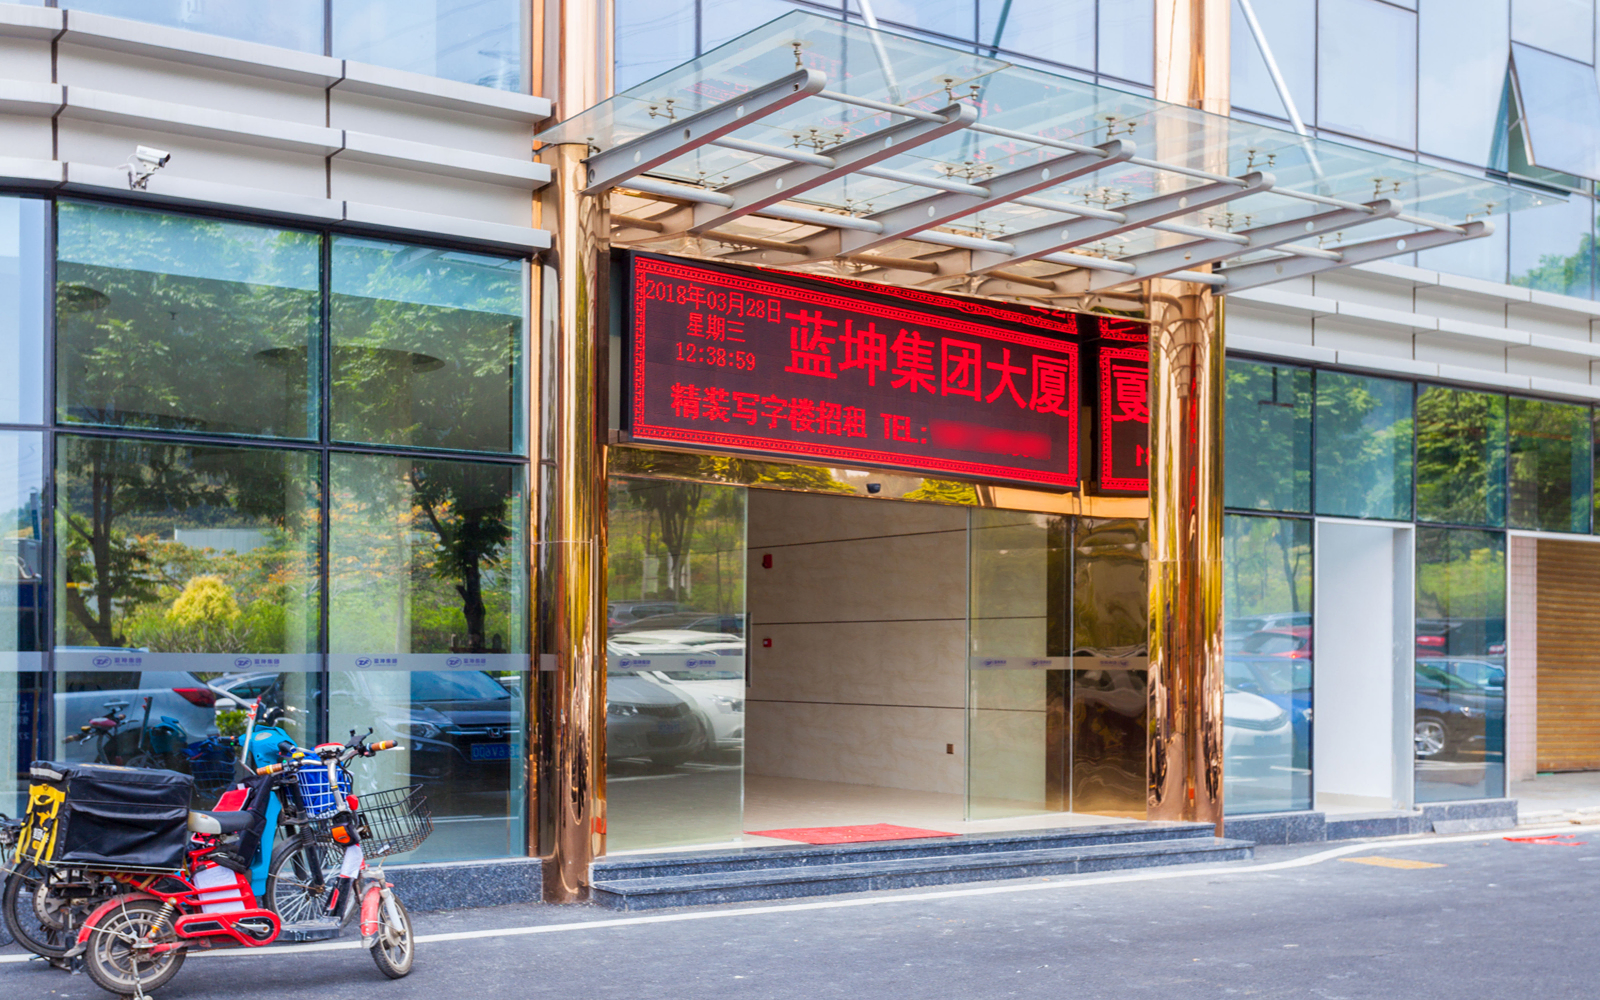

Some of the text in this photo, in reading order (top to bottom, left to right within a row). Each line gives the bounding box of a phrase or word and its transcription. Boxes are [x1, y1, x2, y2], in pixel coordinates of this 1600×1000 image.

[645, 280, 782, 324] 2018年03月28日
[686, 312, 746, 342] 星期三
[676, 341, 756, 371] 12:38:59
[784, 309, 1069, 417] 蓝坤集团大厦
[670, 382, 867, 438] 精装写字楼招租
